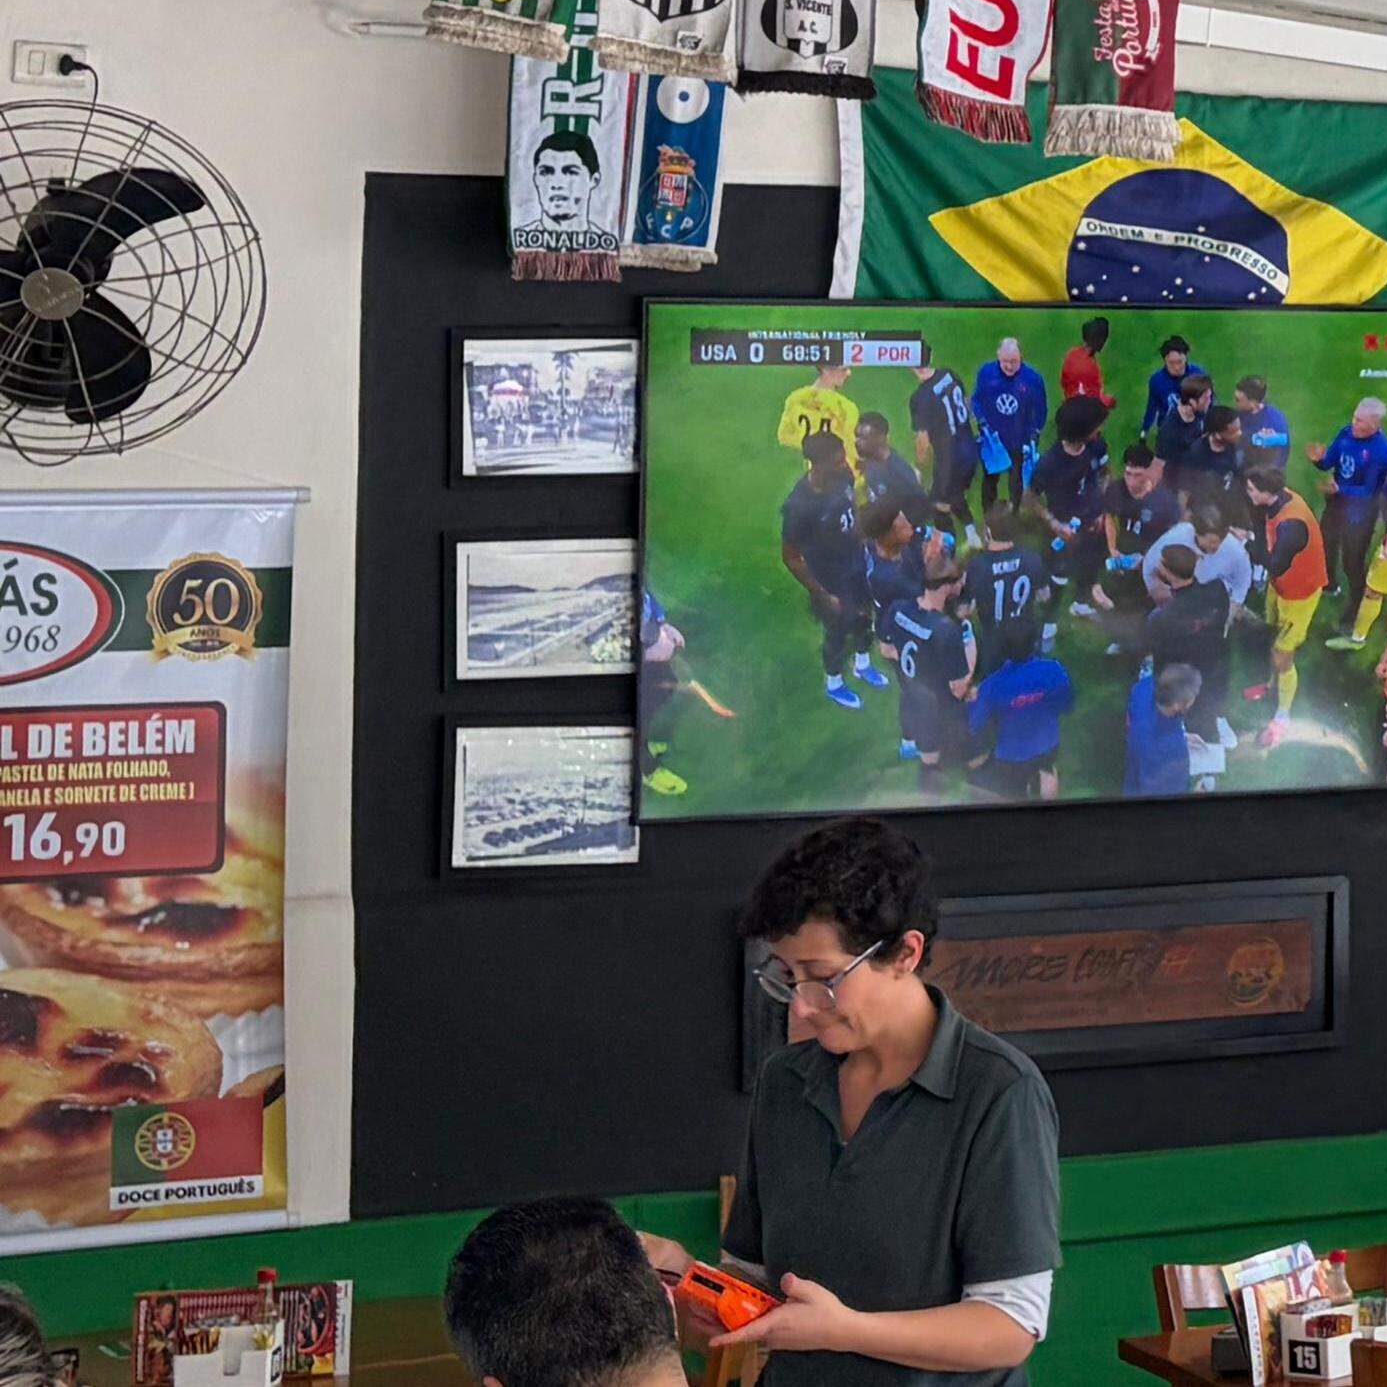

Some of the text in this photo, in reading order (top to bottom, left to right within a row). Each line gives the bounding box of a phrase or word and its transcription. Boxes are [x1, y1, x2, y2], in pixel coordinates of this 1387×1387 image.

[514, 228, 618, 252] RONALDO
[1086, 221, 1278, 281] ORDEM E PROGRESSO
[701, 344, 736, 361] USA
[750, 342, 765, 363] 0
[852, 344, 863, 362] 2
[878, 345, 910, 361] POR
[173, 578, 241, 625] 50
[994, 575, 1031, 621] 19
[901, 640, 917, 678] 6
[27, 723, 73, 759] DE
[82, 713, 196, 757] BELÉM
[48, 764, 65, 781] DE
[68, 762, 103, 779] NATA
[54, 785, 116, 804] SORVETE
[119, 785, 137, 801] DE
[140, 783, 187, 800] CREME
[3, 812, 126, 865] 16,90
[118, 1178, 255, 1204] DOCE PORTUGUÊS
[1293, 1345, 1317, 1369] 15
